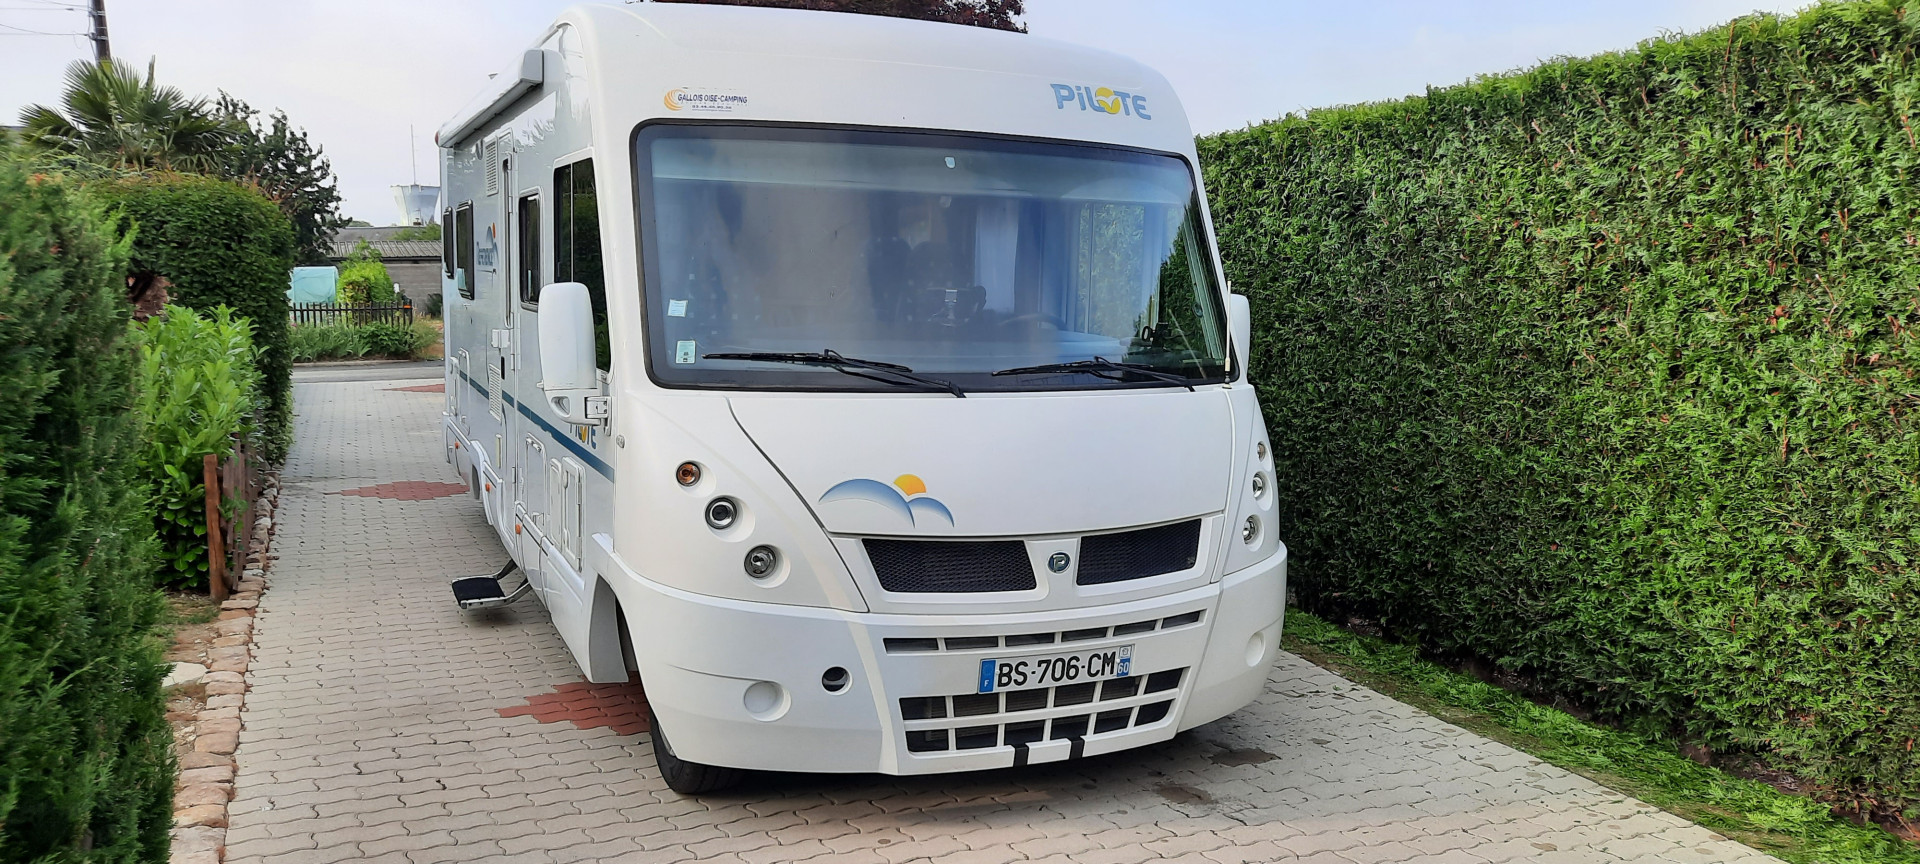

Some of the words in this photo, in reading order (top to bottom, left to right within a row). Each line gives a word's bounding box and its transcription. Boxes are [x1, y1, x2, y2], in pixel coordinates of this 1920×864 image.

[678, 94, 703, 102] GALLOIS
[704, 95, 747, 104] OISE-CAMPING
[997, 651, 1116, 688] BS-706-CM
[1118, 661, 1129, 674] 60
[984, 679, 989, 687] F
